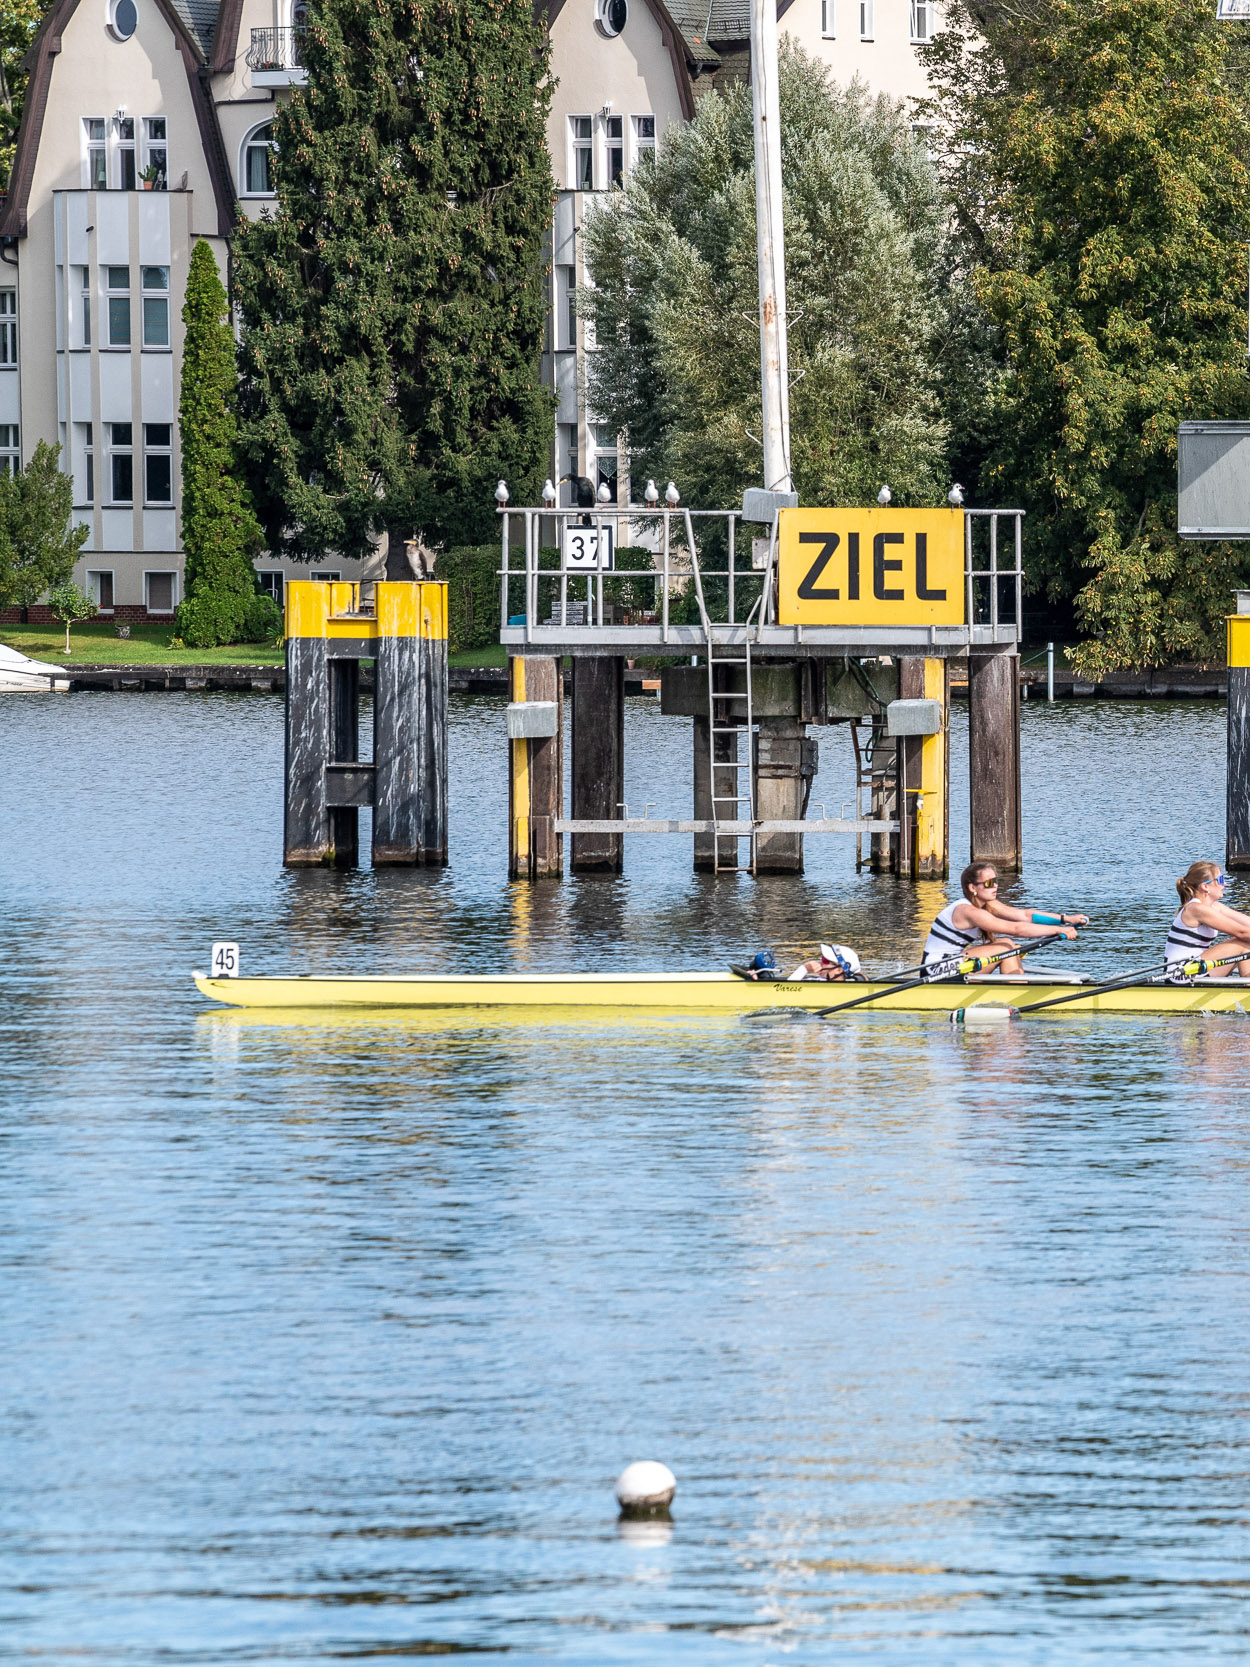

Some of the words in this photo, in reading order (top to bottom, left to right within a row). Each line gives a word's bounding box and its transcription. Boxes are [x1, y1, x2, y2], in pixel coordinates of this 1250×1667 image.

[571, 535, 603, 561] 37
[797, 532, 947, 601] ZIEL
[215, 948, 235, 970] 45
[773, 983, 803, 992] Varese
